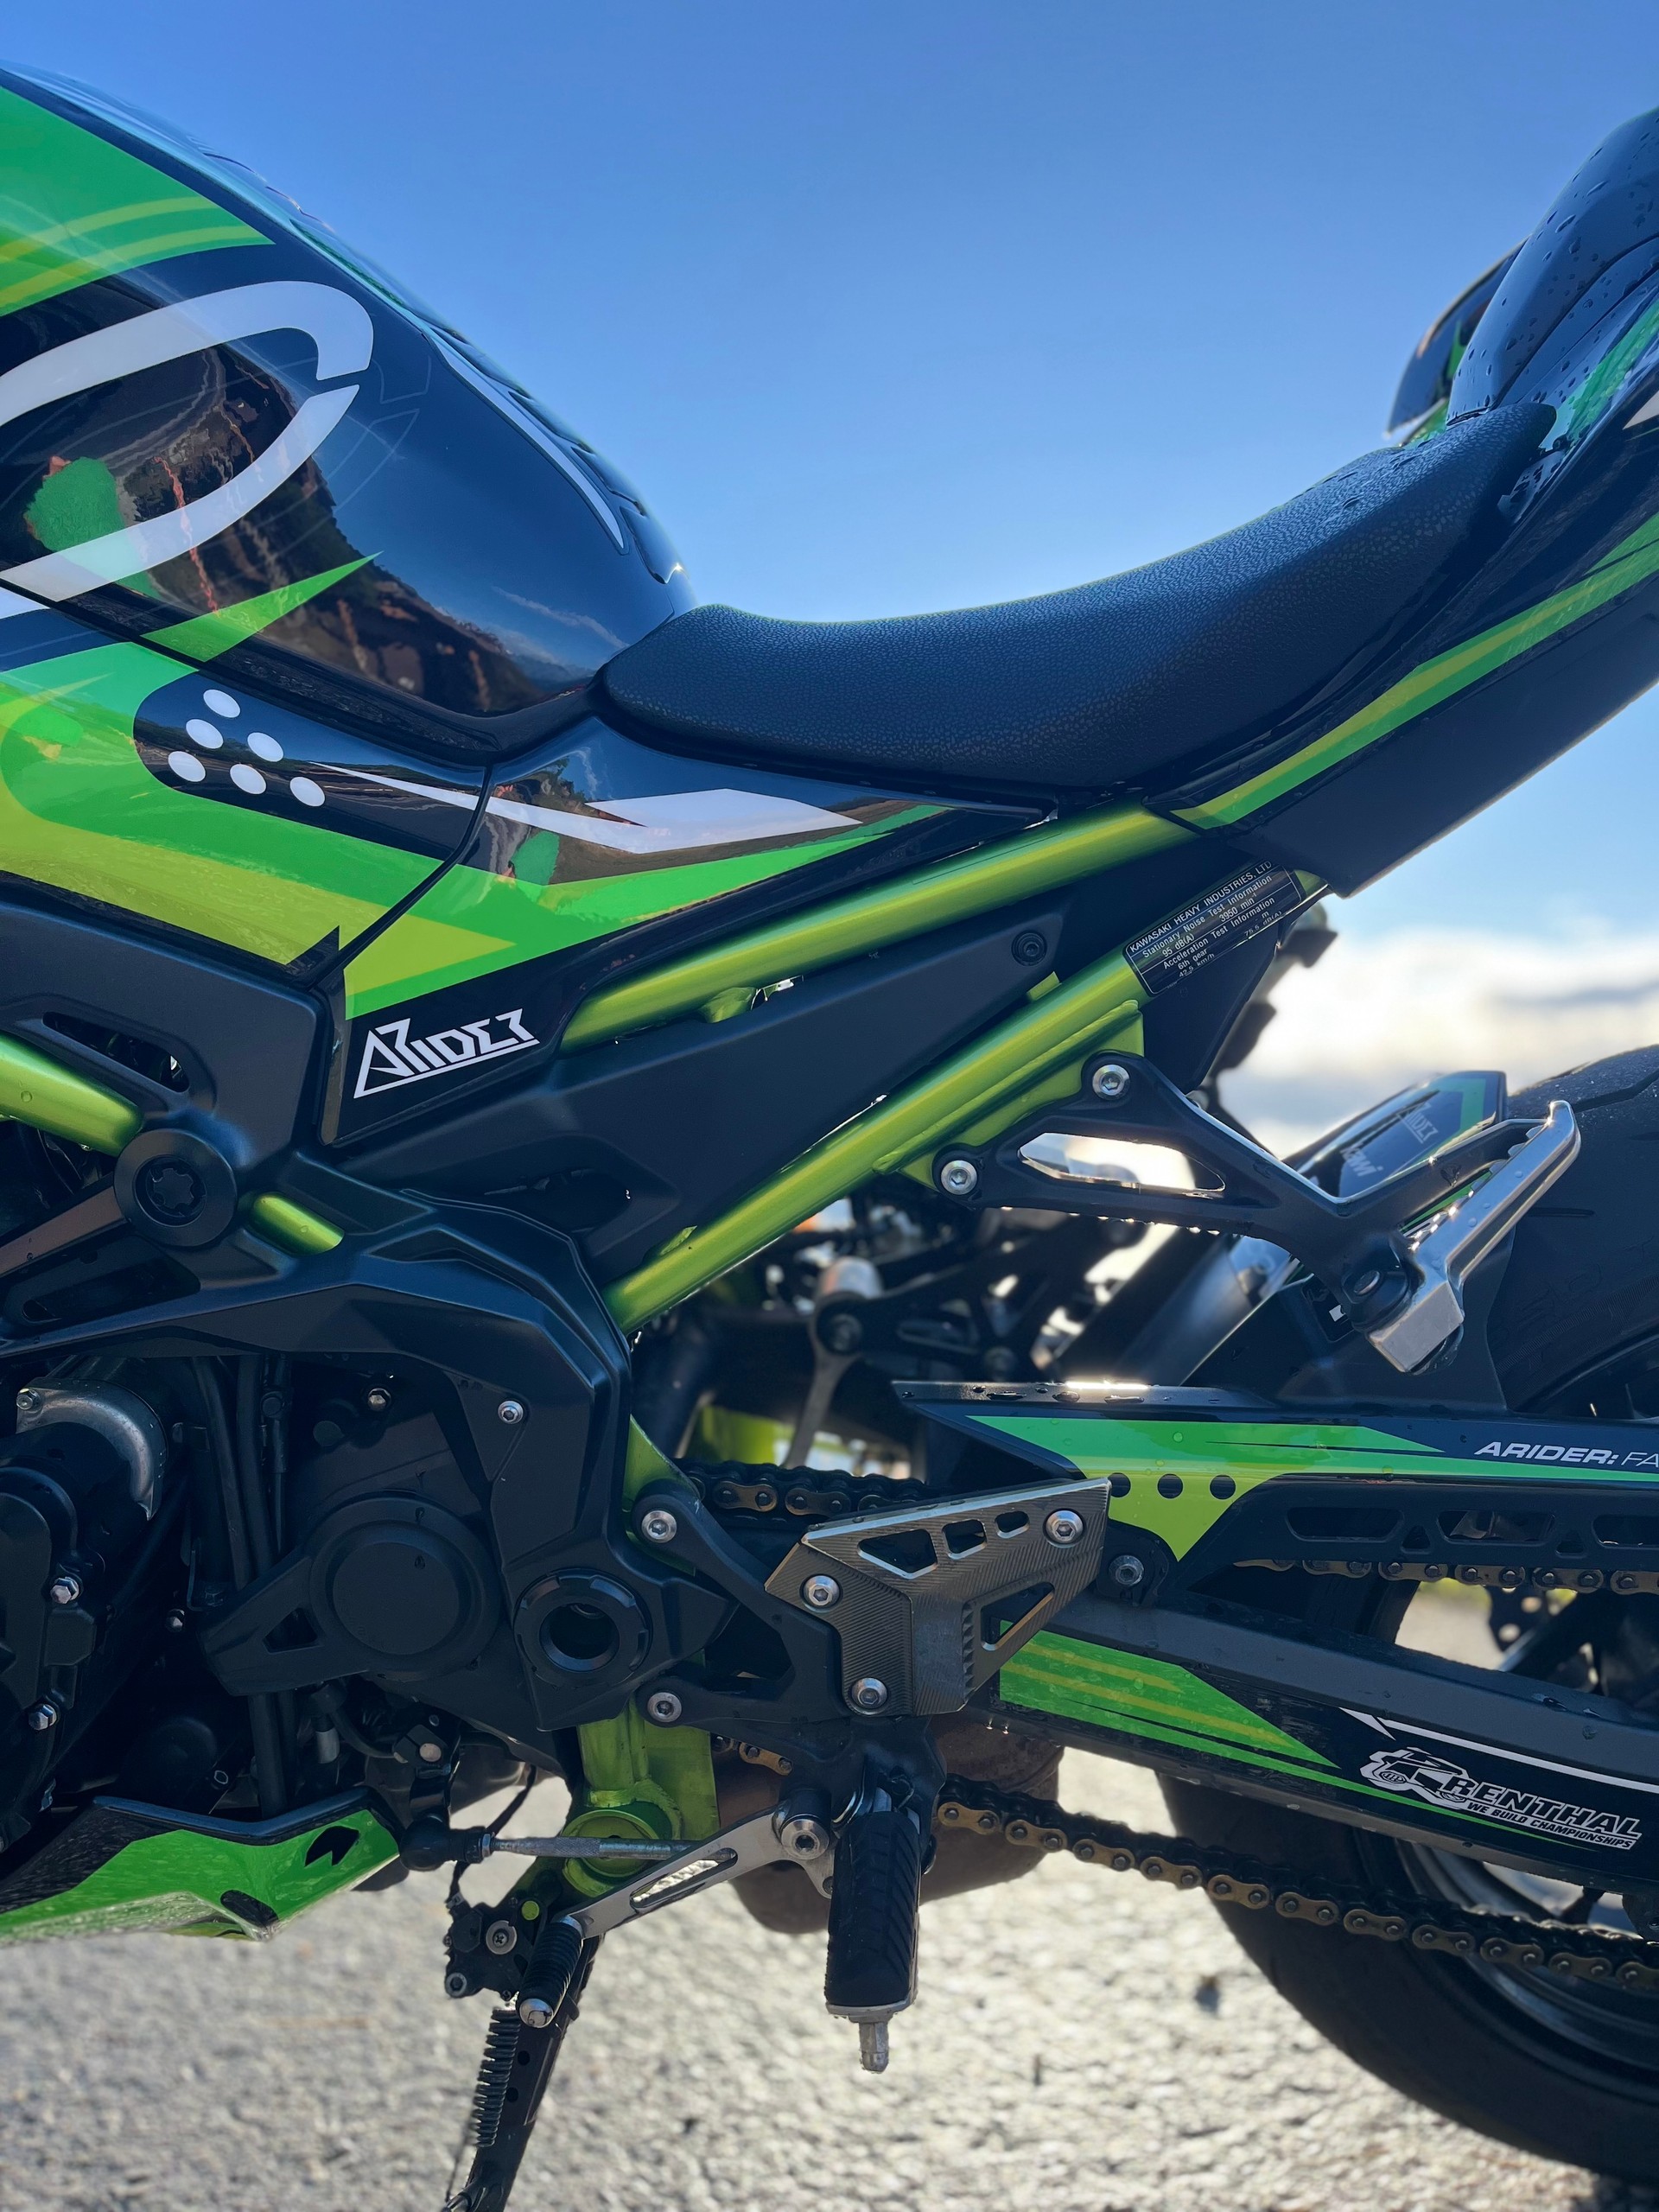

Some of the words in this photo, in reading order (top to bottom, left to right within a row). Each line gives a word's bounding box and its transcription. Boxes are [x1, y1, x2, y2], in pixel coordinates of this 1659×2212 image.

[1129, 922, 1172, 953] KAWASAKI
[1173, 904, 1201, 925] HEAVY
[1142, 931, 1181, 958] Stationary
[1185, 915, 1205, 932] Noise
[1208, 902, 1225, 917] Test
[1228, 874, 1273, 905] Information
[1162, 945, 1173, 957] 95
[1174, 932, 1195, 950] dB(A)
[1218, 906, 1238, 922] 3950
[1163, 938, 1209, 969] Acceleration
[1211, 925, 1229, 940] Test
[1231, 897, 1275, 927] Information
[1178, 958, 1191, 970] 6th
[1192, 949, 1208, 963] gear
[1197, 952, 1215, 966] km/h
[1473, 1441, 1619, 1465] ARIDER:
[1444, 1775, 1643, 1838] RENTHAL
[1467, 1801, 1490, 1815] WE
[1492, 1808, 1529, 1824] BUILD
[1529, 1819, 1633, 1849] CHAMPIONSHIPS
